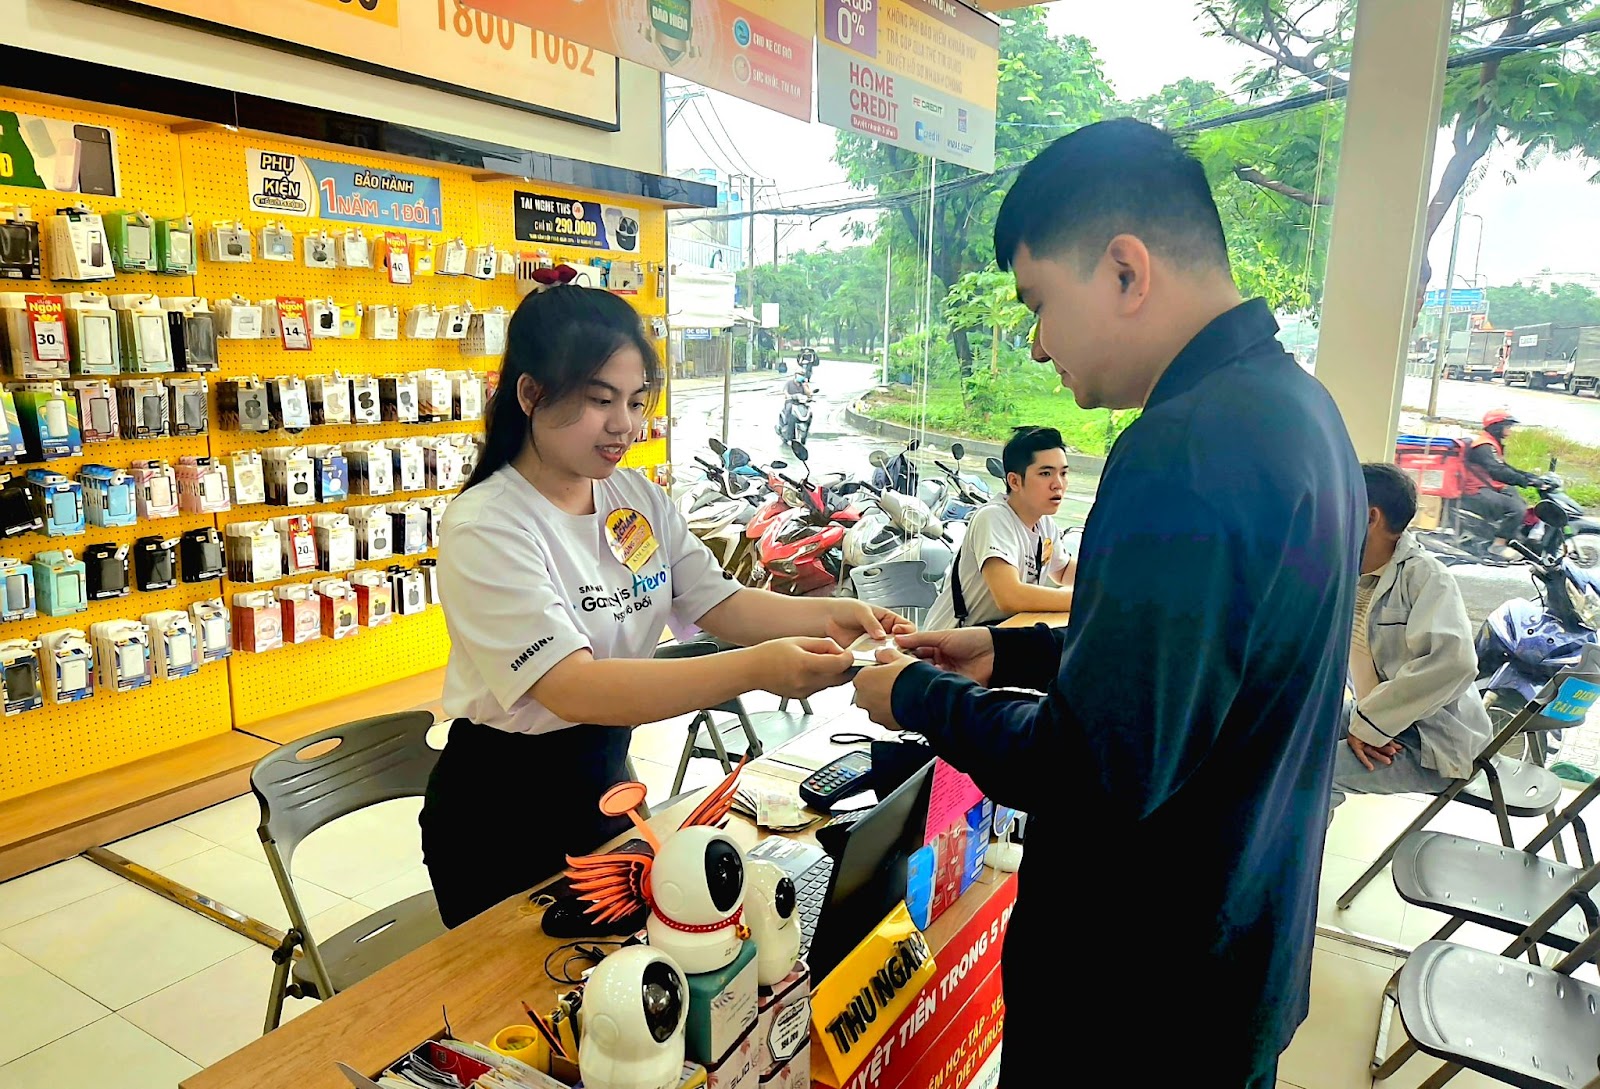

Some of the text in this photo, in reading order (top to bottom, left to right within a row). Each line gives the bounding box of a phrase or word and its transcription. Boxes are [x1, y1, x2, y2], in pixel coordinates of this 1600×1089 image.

[838, 7, 865, 45] 0%
[850, 61, 894, 98] HOME
[850, 89, 899, 123] CREDIT
[921, 100, 943, 115] CREDIT
[261, 153, 294, 176] PHỤ
[263, 177, 300, 199] KIỆN
[354, 170, 414, 193] BẢO HÀNH
[401, 199, 431, 225] ĐỔI
[37, 334, 55, 345] 30
[285, 327, 299, 336] 14
[298, 545, 309, 554] 20
[632, 571, 666, 597] Hero
[939, 934, 988, 1001] TRONG
[990, 920, 1000, 945] 5
[825, 985, 877, 1055] THU
[945, 1039, 967, 1078] HỌC
[955, 1013, 1004, 1089] DIỆT VIRUS
